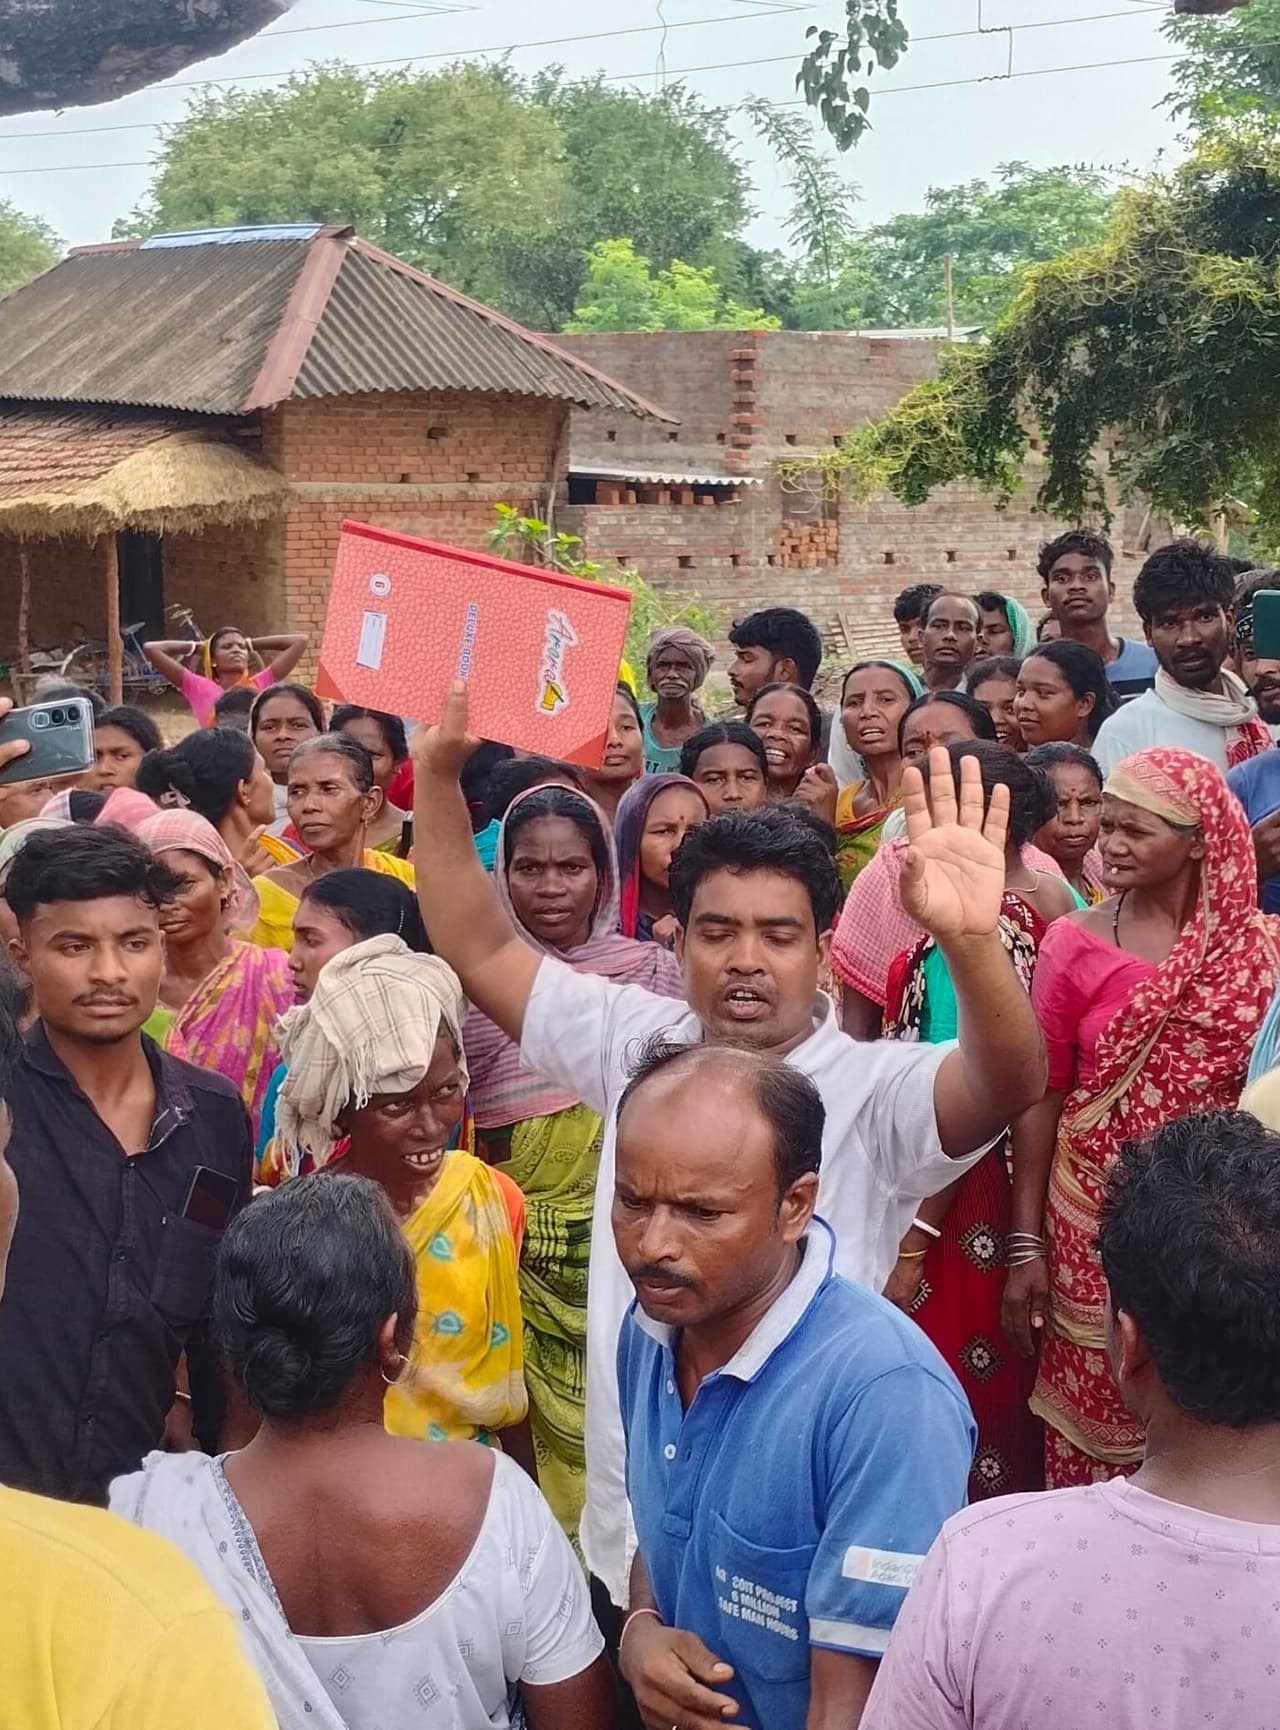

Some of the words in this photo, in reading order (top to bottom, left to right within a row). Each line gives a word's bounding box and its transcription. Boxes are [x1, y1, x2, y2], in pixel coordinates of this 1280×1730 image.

[465, 604, 478, 645] DELUXE
[459, 647, 472, 678] BOOK
[740, 1593, 780, 1619] MILLION
